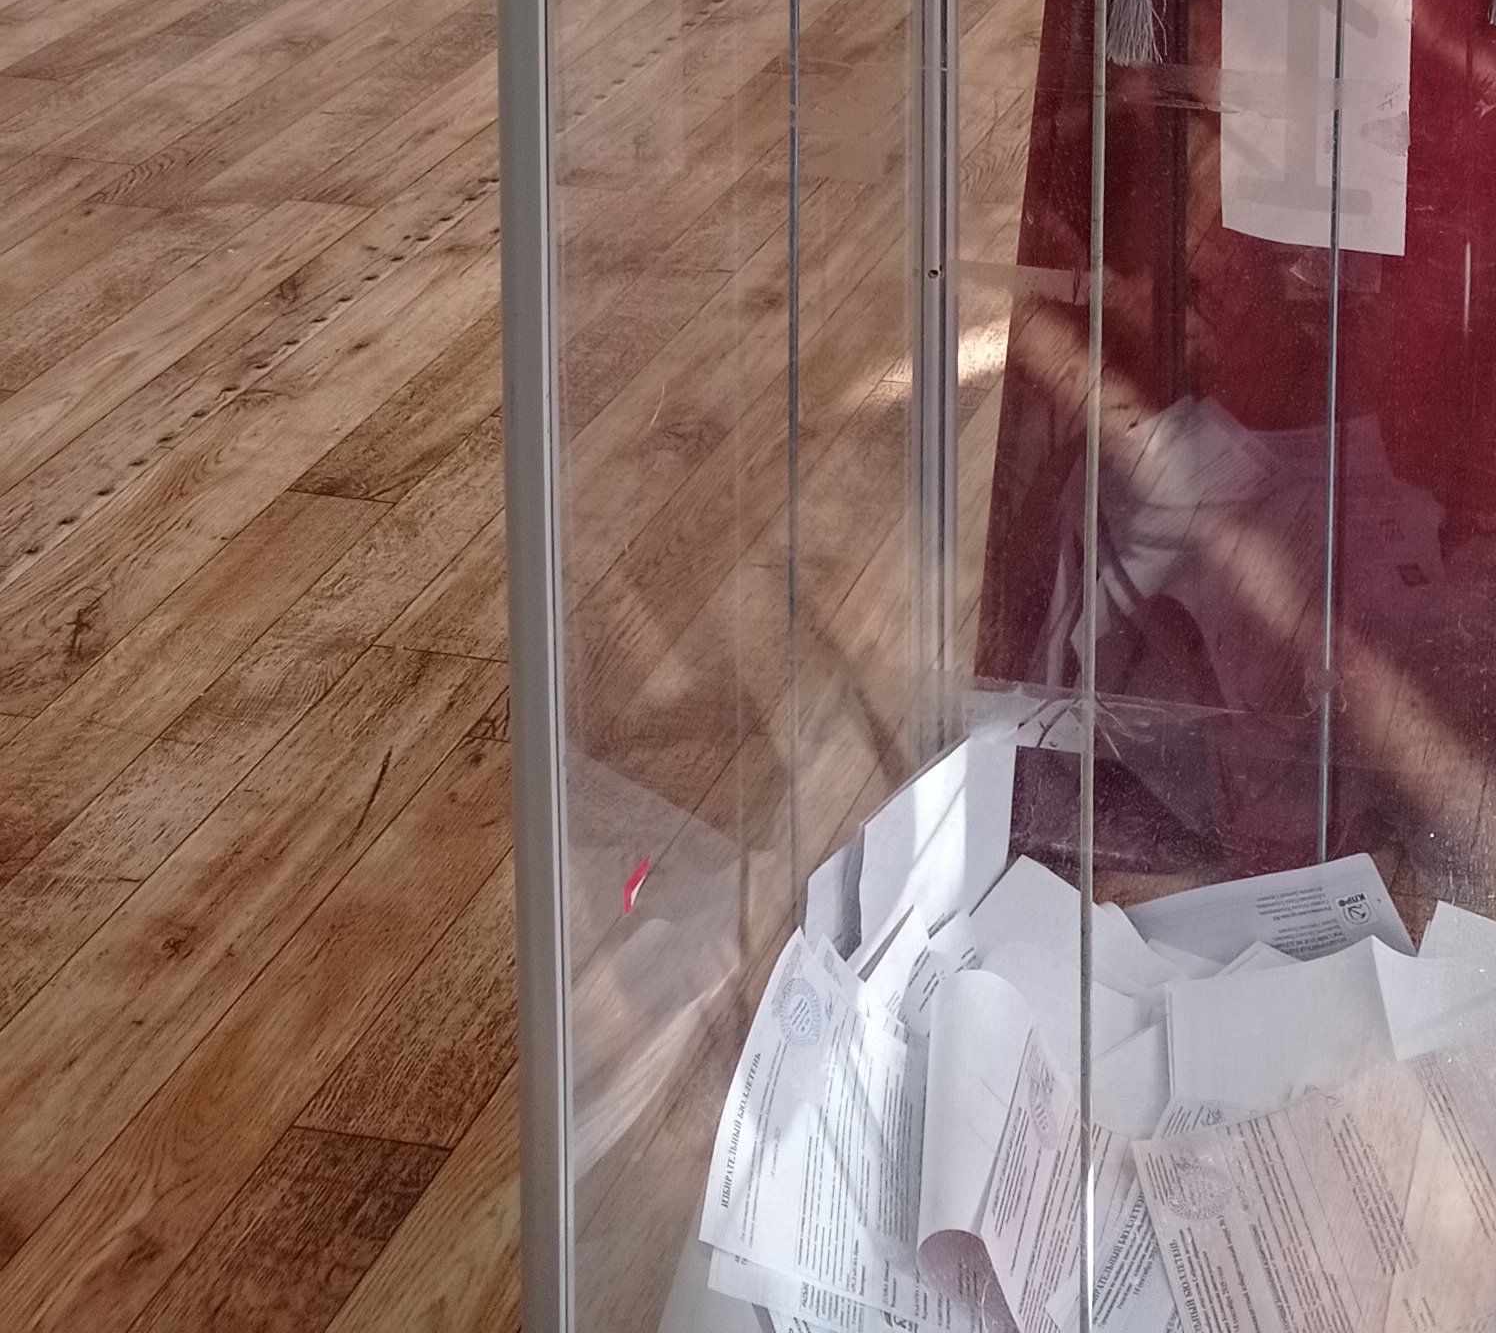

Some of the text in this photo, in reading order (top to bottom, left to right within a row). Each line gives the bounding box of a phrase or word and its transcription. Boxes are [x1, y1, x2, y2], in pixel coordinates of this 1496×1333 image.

[1337, 893, 1365, 907] КПРФ
[720, 1052, 761, 1208] ИЗБИРАТЕЛЬНЫЙ БЮЛЛЕТЕНЬ
[1092, 1190, 1144, 1304] ИРАТЕЛЬНЫЙ БЮЛЛЕТЕН
